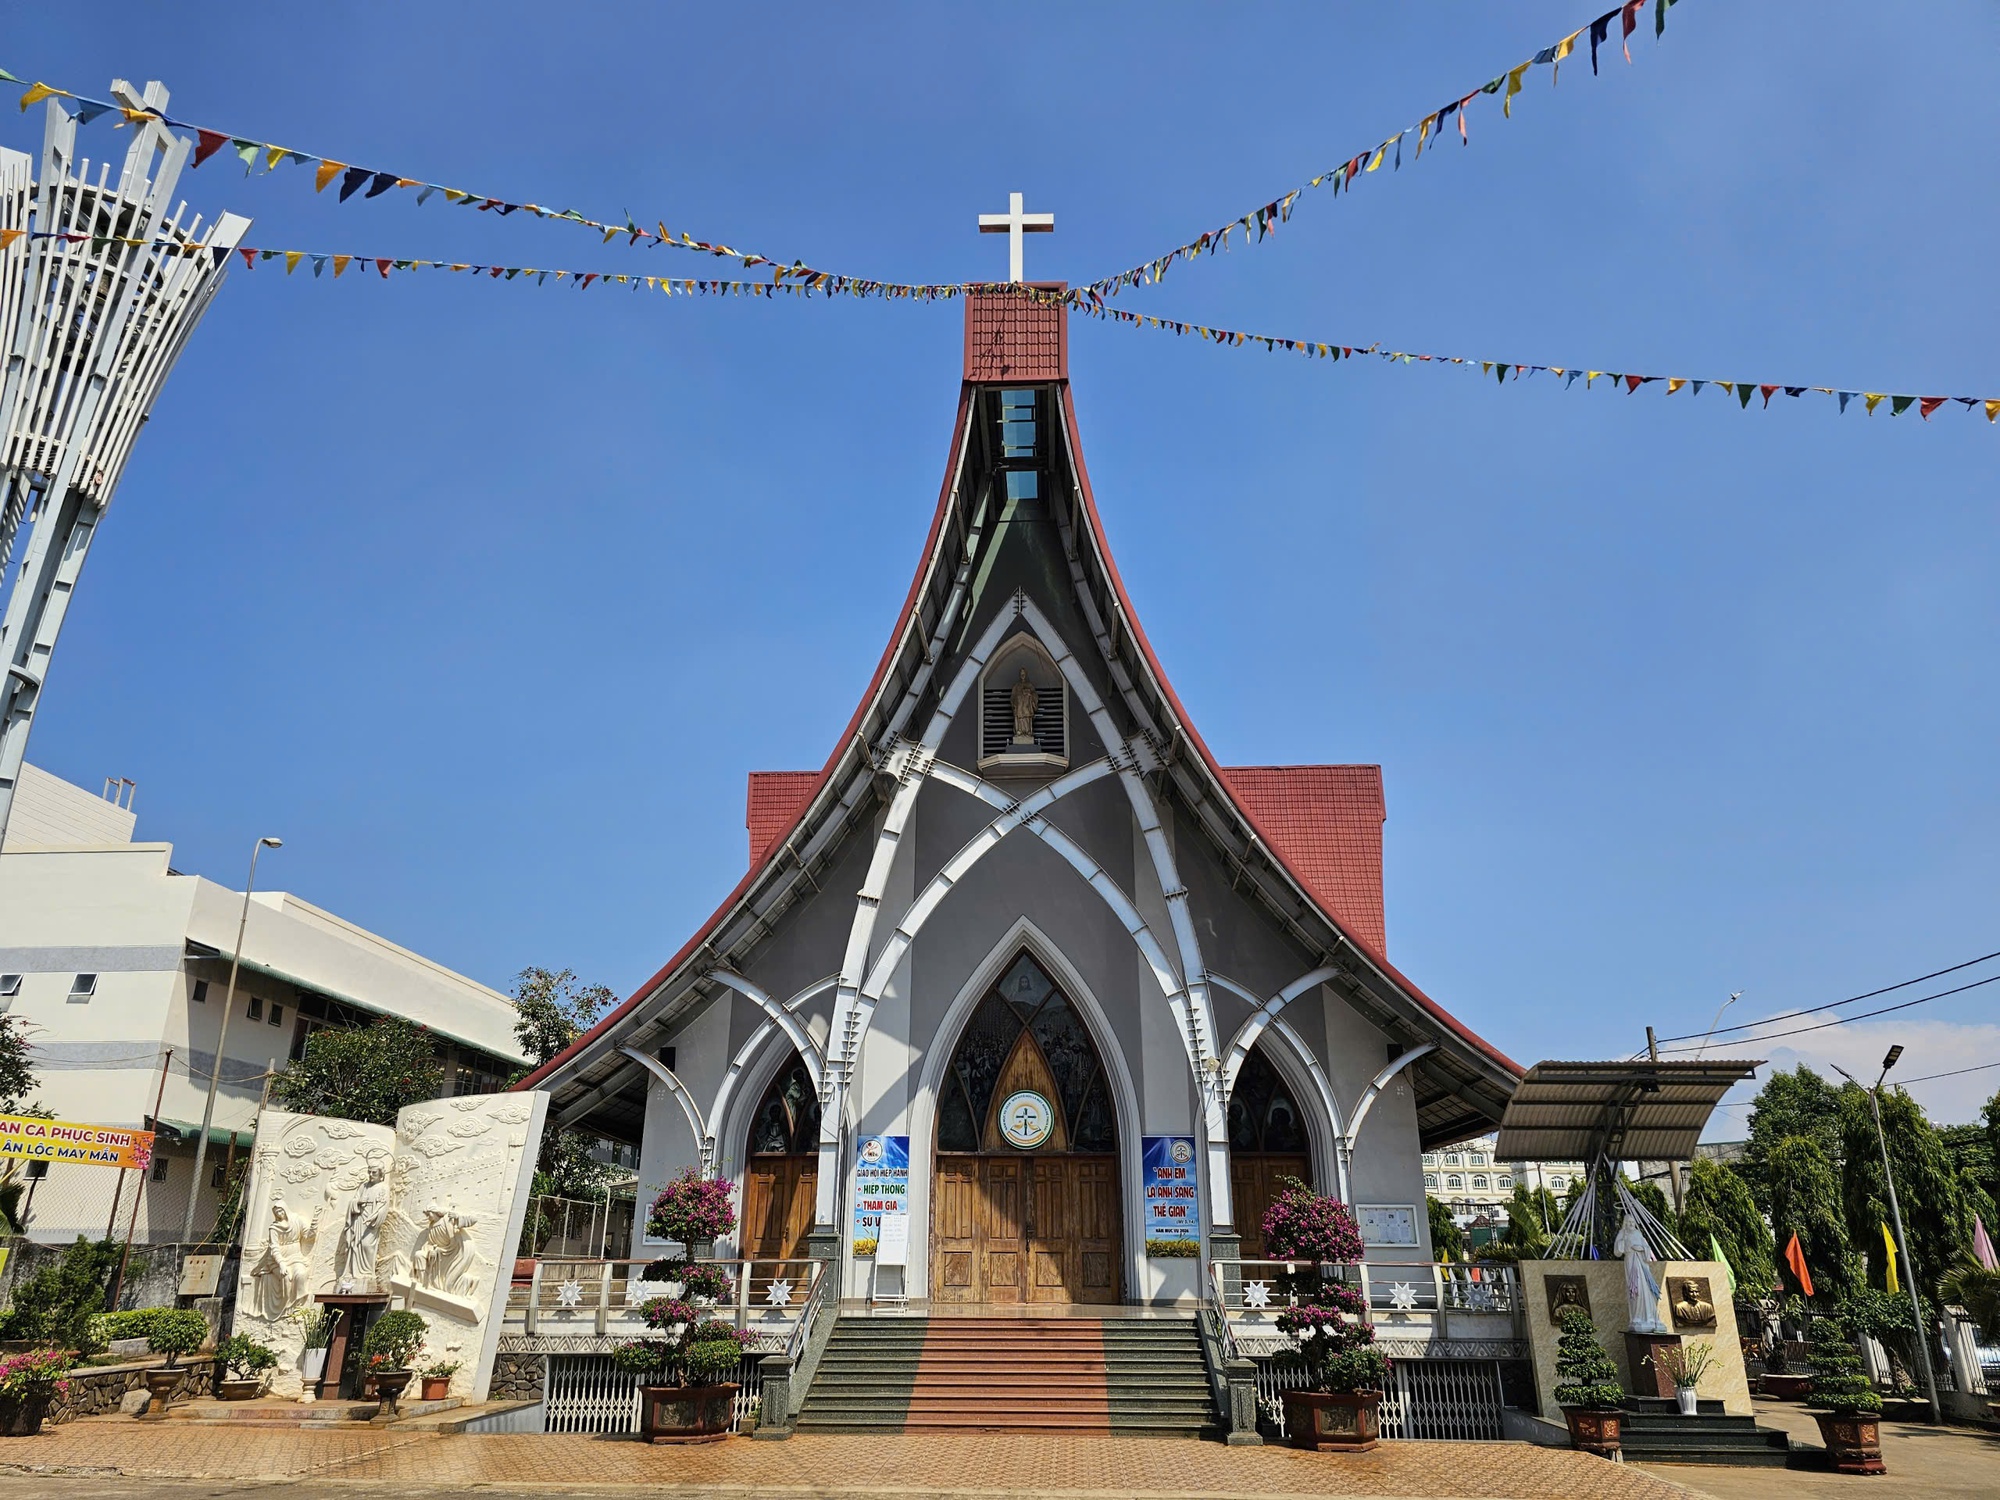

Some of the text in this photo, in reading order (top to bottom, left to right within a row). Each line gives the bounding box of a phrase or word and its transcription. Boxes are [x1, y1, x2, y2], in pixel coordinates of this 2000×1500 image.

[25, 1124, 46, 1137] CA
[51, 1127, 94, 1144] PHỤC
[96, 1132, 131, 1146] SINH
[2, 1139, 118, 1162] ÂN LỘC MAY MẮN
[1175, 1167, 1186, 1179] EM
[863, 1200, 898, 1211] THAM GIA
